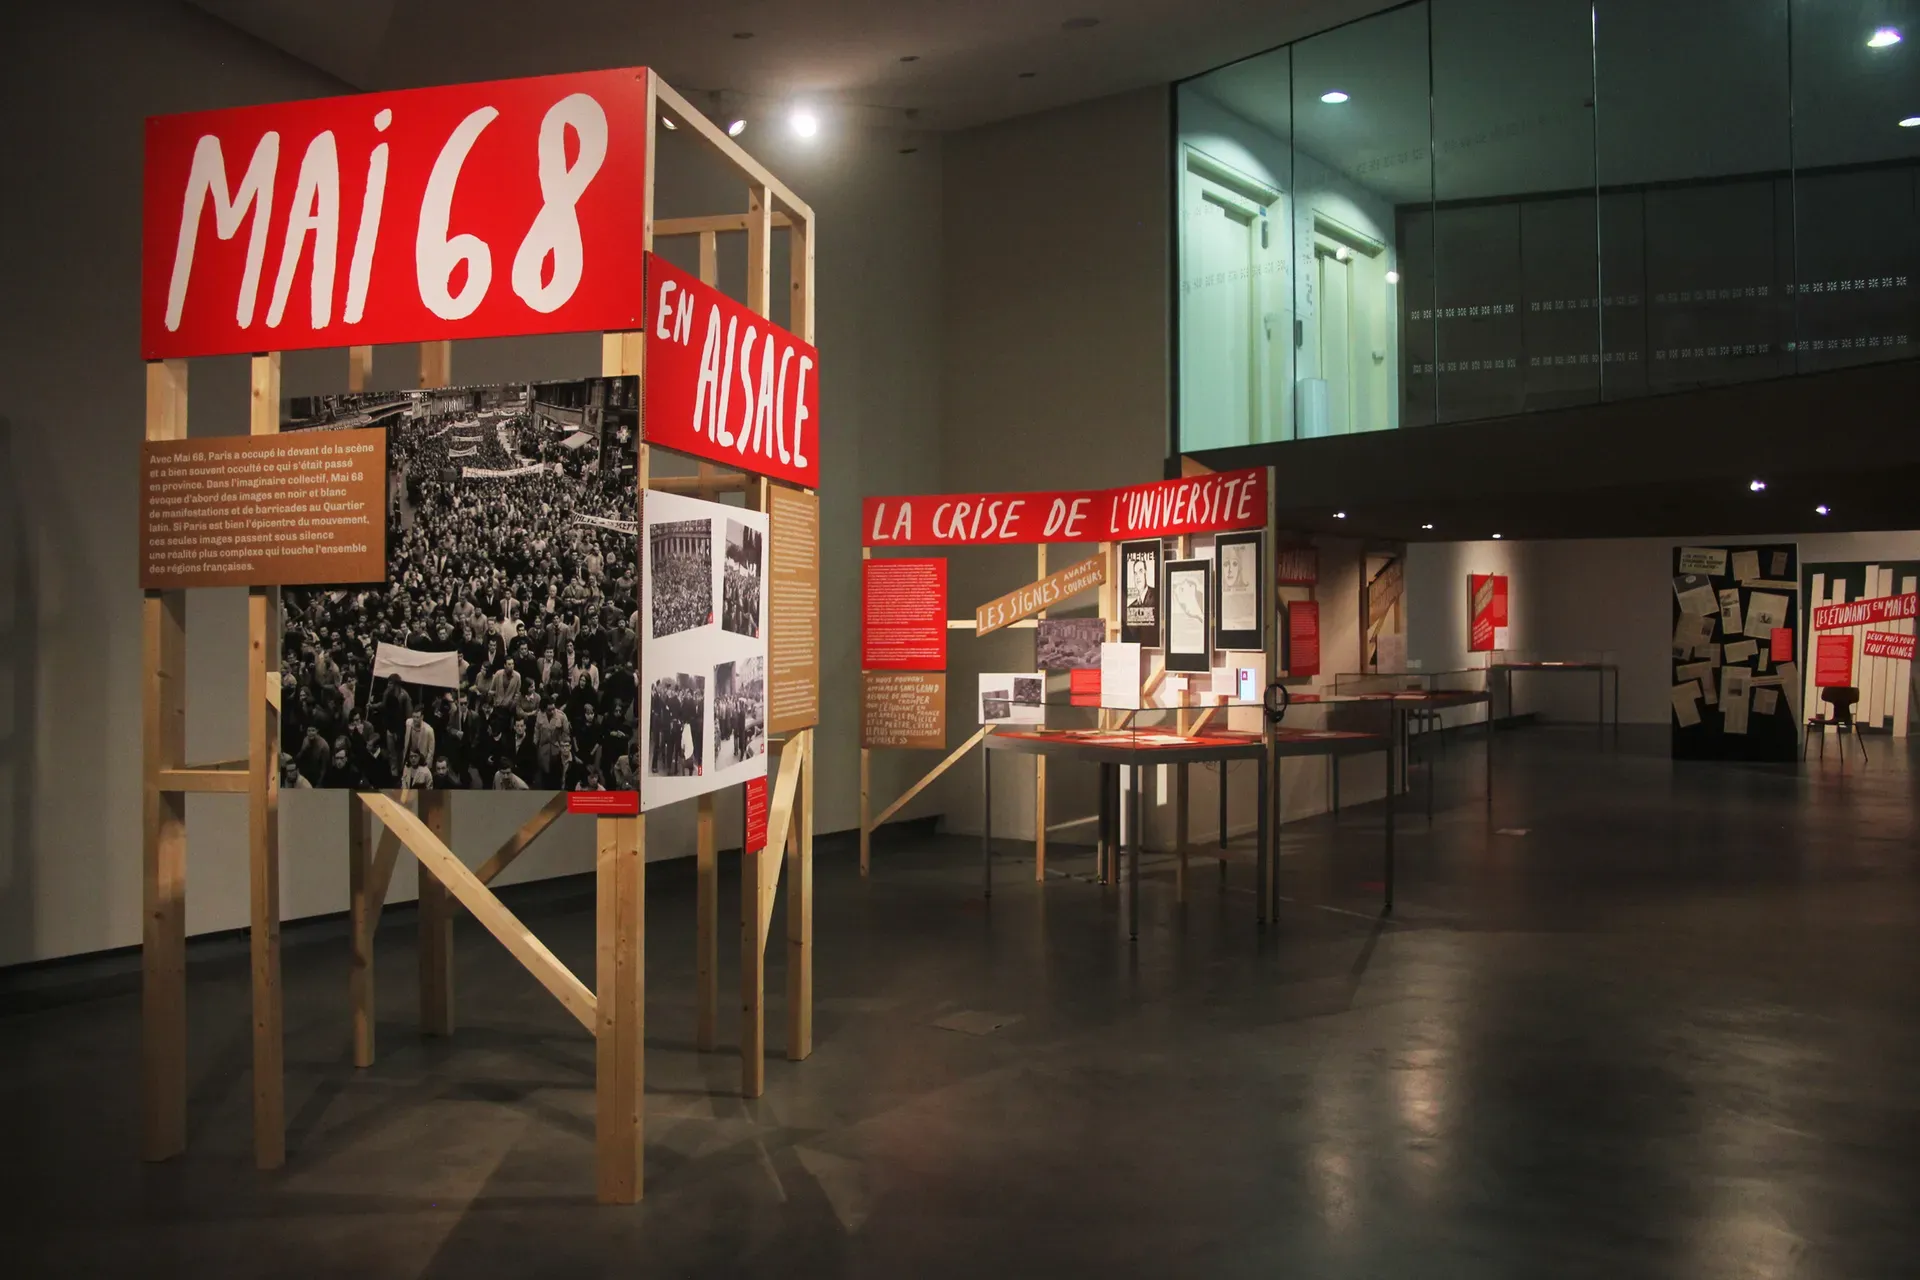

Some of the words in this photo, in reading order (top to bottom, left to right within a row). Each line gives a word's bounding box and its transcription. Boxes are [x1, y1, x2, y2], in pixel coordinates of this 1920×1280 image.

[415, 92, 609, 321] 68
[656, 280, 694, 346] EN
[693, 303, 813, 468] ALSACE
[150, 455, 172, 464] Avec
[174, 453, 190, 463] Mai
[192, 452, 207, 462] 68,
[208, 451, 232, 460] Paris
[242, 448, 275, 460] occupé
[277, 448, 285, 457] le
[288, 446, 319, 456] devant
[321, 445, 333, 455] de
[335, 444, 344, 454] la
[345, 443, 374, 453] scène
[150, 469, 158, 478] et
[168, 468, 187, 476] bien
[189, 466, 225, 476] souvent
[227, 463, 261, 473] occulté
[264, 464, 274, 472] ce
[276, 461, 291, 472] qui
[293, 460, 323, 470] s'était
[325, 458, 353, 470] passé
[150, 484, 160, 492] en
[163, 481, 204, 493] province.
[207, 479, 229, 488] Dans
[232, 476, 286, 488] l'imaginaire
[288, 474, 329, 485] collectif,
[331, 473, 349, 482] Mai
[351, 472, 364, 481] 68
[150, 496, 182, 506] évoque
[184, 493, 219, 504] d'abord
[221, 492, 237, 502] des
[240, 491, 272, 502] images
[274, 491, 286, 499] en
[288, 489, 307, 498] noir
[309, 488, 319, 497] et
[320, 487, 347, 497] blanc
[149, 510, 160, 519] de
[162, 506, 229, 518] manifestations
[231, 506, 240, 514] et
[242, 505, 254, 514] de
[256, 504, 307, 514] barricades
[310, 504, 321, 512] au
[324, 500, 365, 512] Quartier
[872, 502, 912, 541] LA
[1043, 498, 1091, 537] DE
[150, 523, 171, 532] latin.
[173, 522, 182, 531] Si
[184, 522, 207, 531] Paris
[209, 522, 223, 530] est
[225, 520, 244, 529] bien
[246, 518, 296, 530] l'épicentre
[298, 518, 310, 526] du
[312, 516, 370, 525] mouvement,
[150, 538, 165, 546] ces
[167, 536, 197, 545] seules
[200, 535, 232, 545] images
[235, 533, 272, 544] passent
[275, 533, 297, 541] sous
[300, 531, 334, 540] silence
[149, 552, 166, 560] une
[168, 550, 197, 559] réalité
[199, 549, 218, 559] plus
[220, 547, 263, 559] complexe
[265, 547, 280, 557] qui
[282, 546, 314, 555] touche
[316, 543, 367, 554] l'ensemble
[149, 564, 165, 573] des
[167, 563, 201, 574] régions
[203, 562, 254, 573] françaises.
[1064, 560, 1097, 581] AVANT-
[1064, 570, 1103, 595] COUREURS
[979, 603, 1004, 633] LES
[1816, 609, 1827, 628] LES
[1873, 601, 1884, 610] EN
[1904, 596, 1916, 615] 68
[1866, 643, 1885, 653] TOUT
[1900, 636, 1915, 645] POUR
[900, 684, 915, 692] SANS
